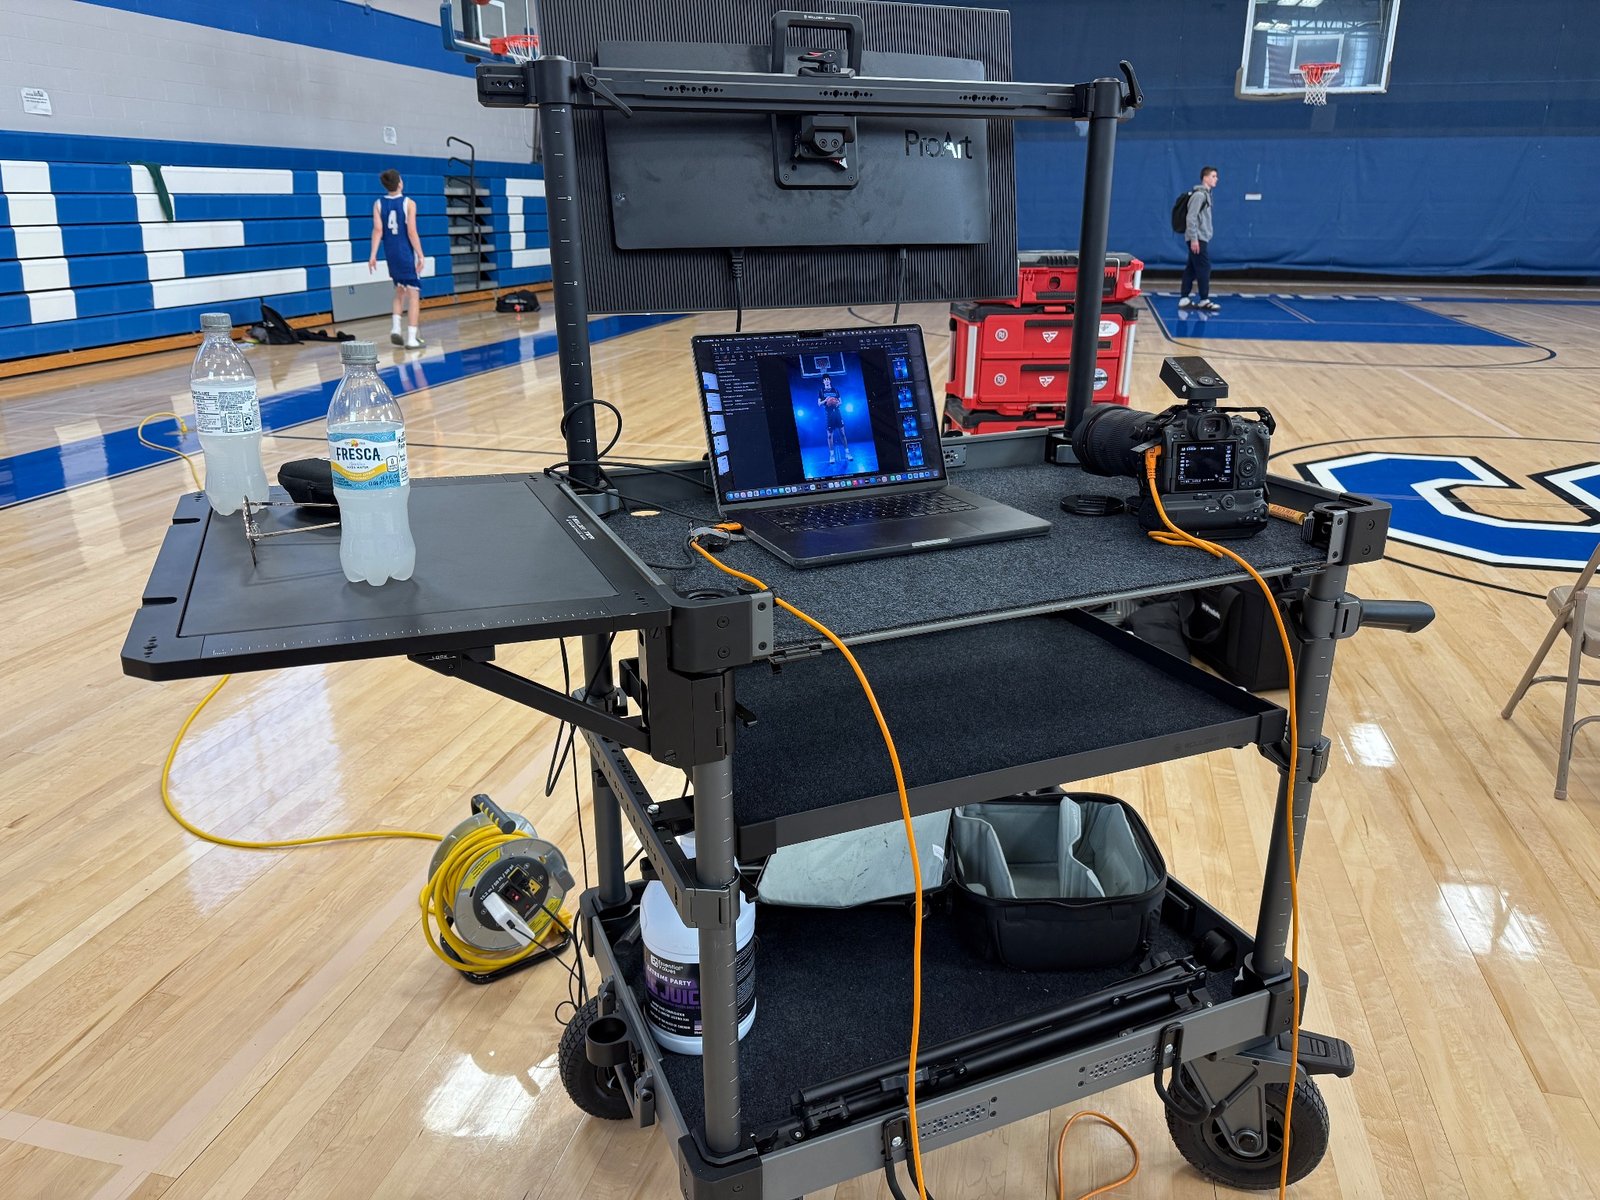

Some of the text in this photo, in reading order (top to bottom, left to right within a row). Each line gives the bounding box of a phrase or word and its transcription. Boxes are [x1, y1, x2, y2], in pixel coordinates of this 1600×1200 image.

[905, 129, 973, 159] ProArt
[388, 210, 399, 235] 4
[336, 446, 381, 461] FRESCA
[646, 964, 668, 982] EXTREME
[669, 978, 692, 986] PARTY
[660, 985, 701, 1006] JUIC
